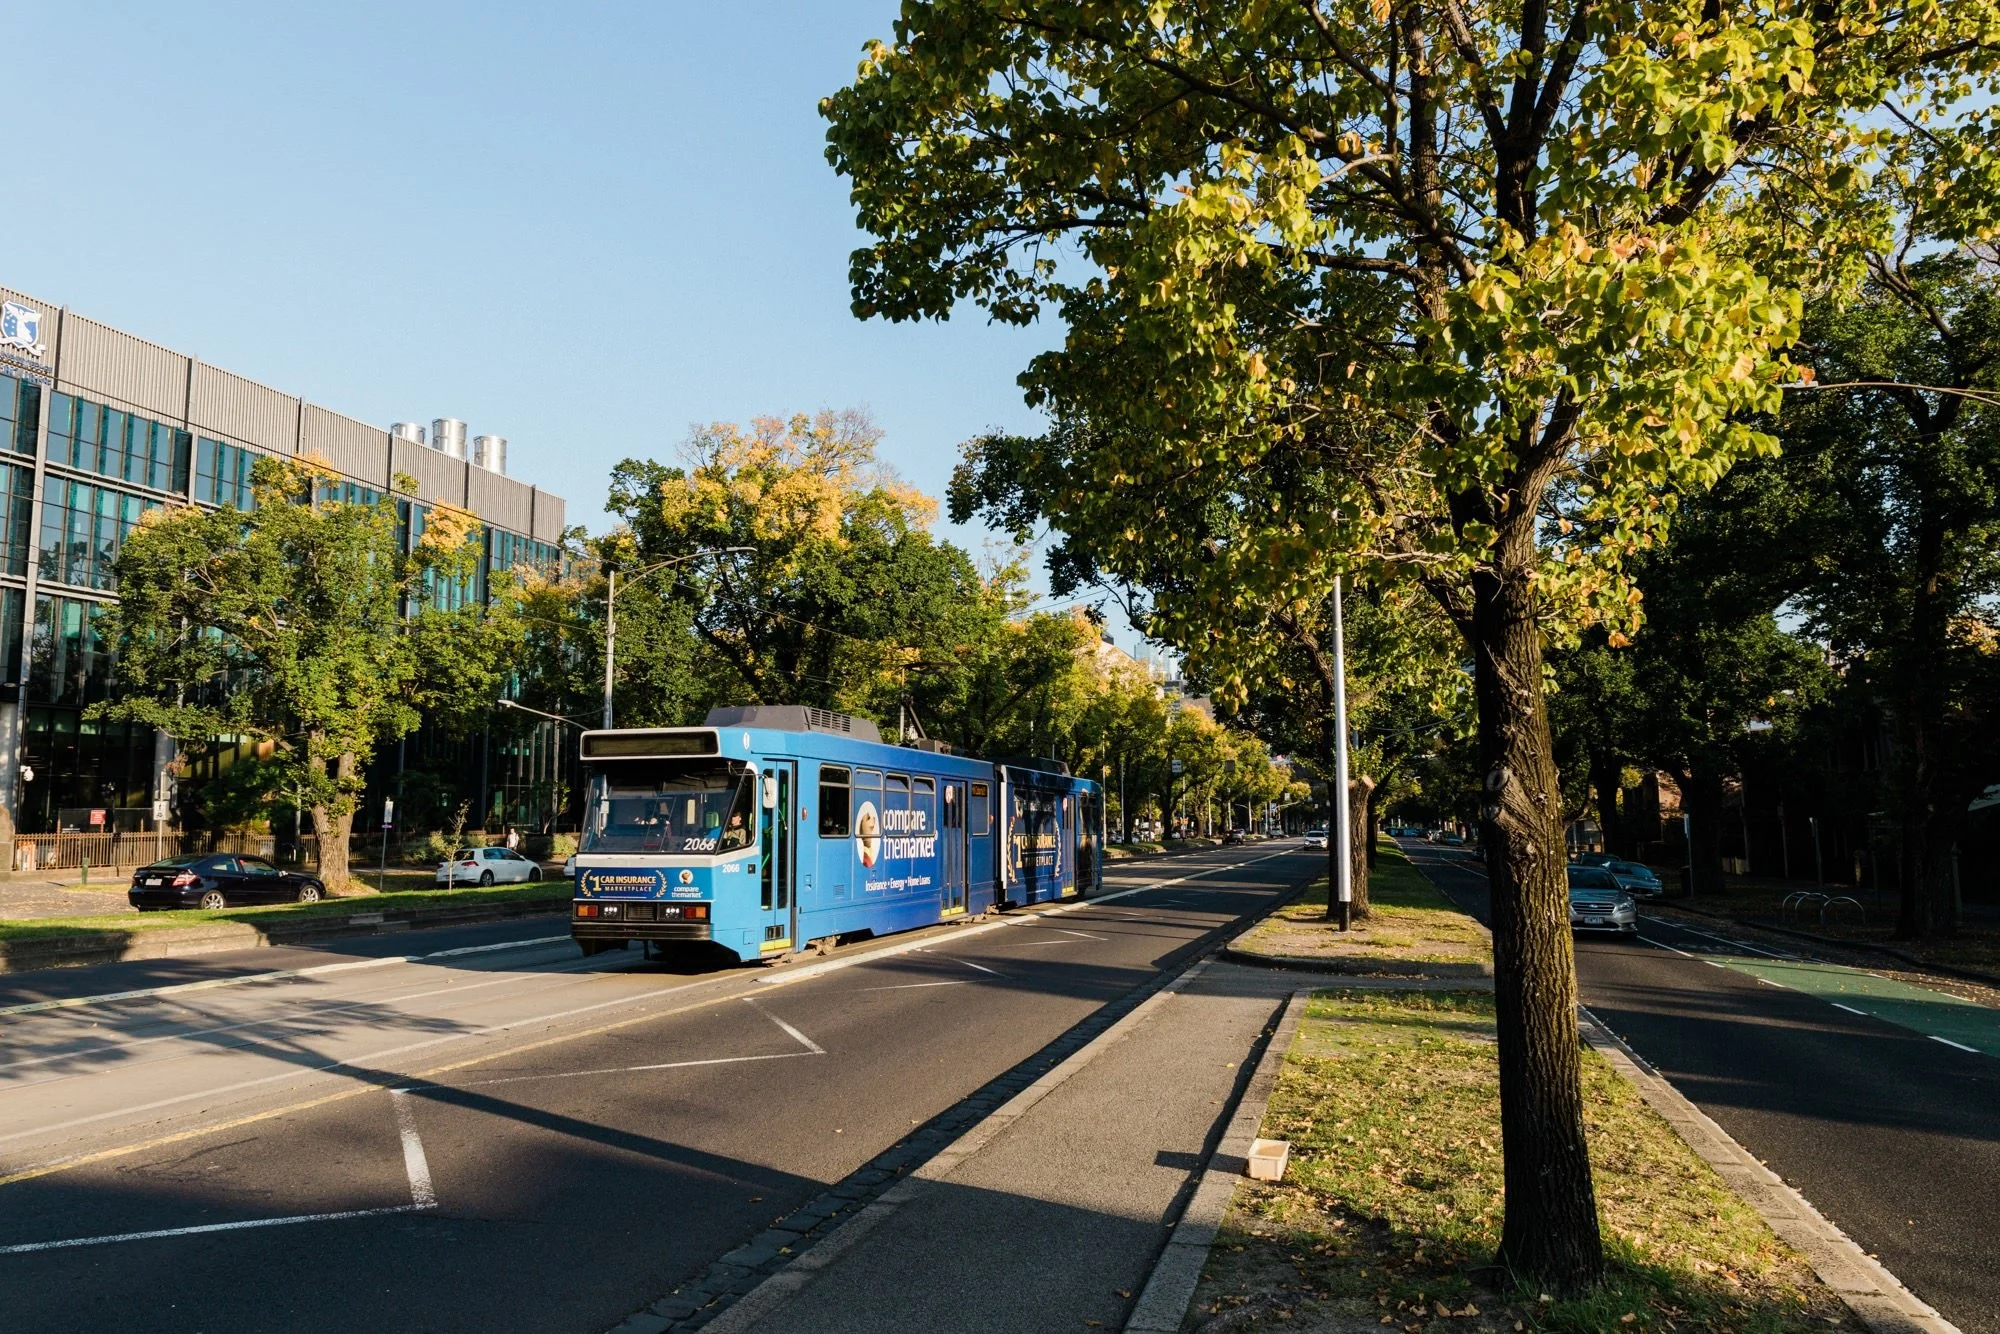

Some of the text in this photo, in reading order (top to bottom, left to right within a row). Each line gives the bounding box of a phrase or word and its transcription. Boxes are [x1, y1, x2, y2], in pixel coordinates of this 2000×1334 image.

[883, 809, 926, 833] compare
[683, 838, 715, 851] 2066
[883, 834, 935, 860] themarket
[600, 875, 657, 884] CAR INSURANCE
